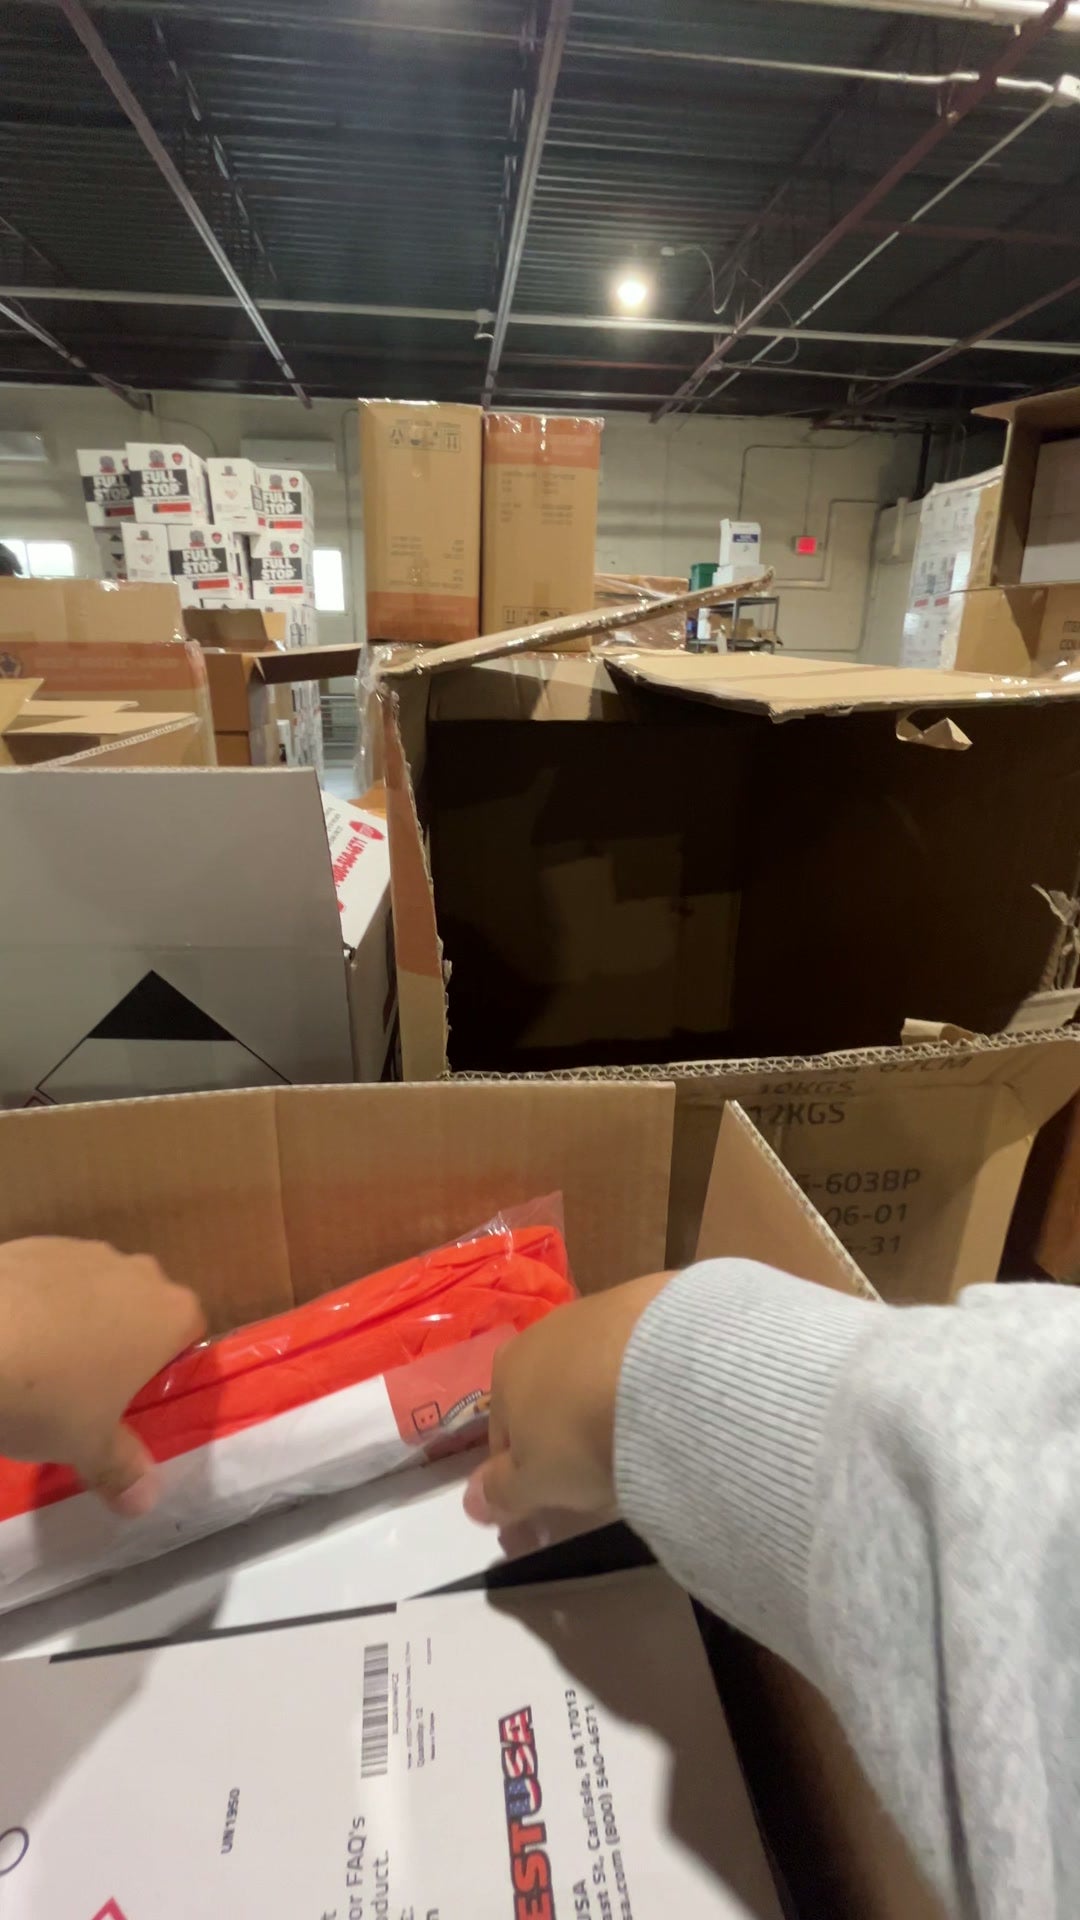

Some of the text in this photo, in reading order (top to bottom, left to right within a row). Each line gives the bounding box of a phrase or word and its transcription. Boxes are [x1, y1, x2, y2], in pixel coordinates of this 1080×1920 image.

[93, 475, 128, 488] FULL
[142, 470, 177, 483] FULL
[93, 487, 131, 501] STOP
[142, 483, 180, 496] STOP
[183, 549, 215, 561] FULL
[182, 561, 220, 574] STOP
[262, 557, 292, 568] FULL
[261, 569, 295, 580] STOP
[565, 1689, 582, 1740] 17013
[584, 1704, 609, 1789] 540-4671
[574, 1744, 587, 1769] PA
[598, 1792, 621, 1846] (800)
[346, 1816, 367, 1887] FAQ's
